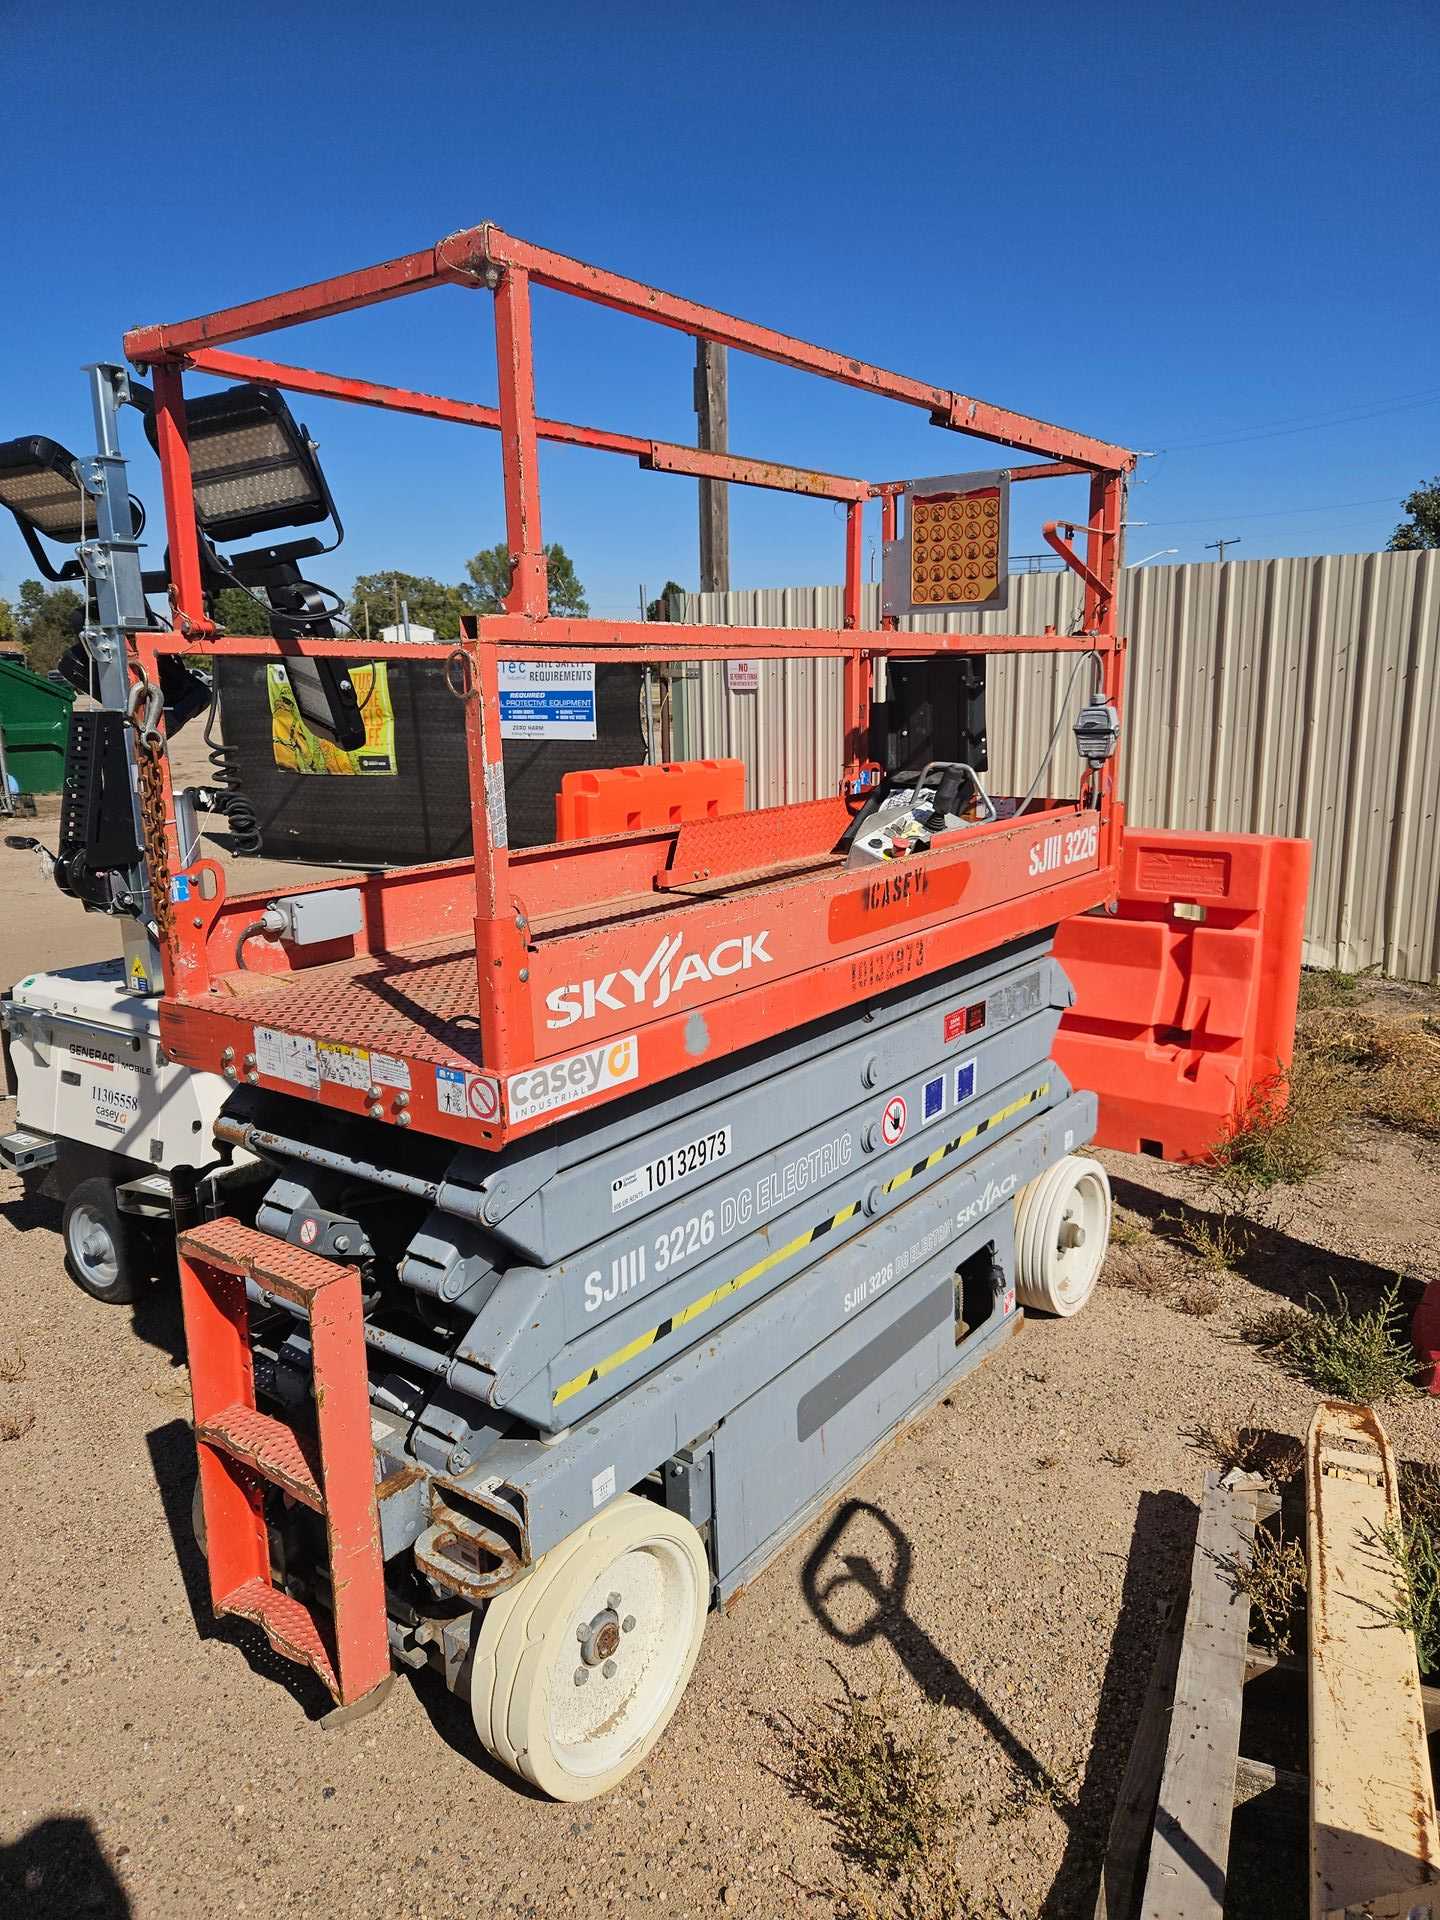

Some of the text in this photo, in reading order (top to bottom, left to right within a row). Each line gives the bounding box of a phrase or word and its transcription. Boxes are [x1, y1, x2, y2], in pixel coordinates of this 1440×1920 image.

[529, 671, 592, 681] REQUIREMENTS
[738, 663, 748, 672] NO
[1029, 826, 1097, 876] SJIII 3226
[871, 868, 922, 910] CASEY
[546, 930, 774, 1029] SKYJACK
[69, 1043, 152, 1075] GENERAC MOBILE
[510, 1050, 606, 1106] casey
[91, 1086, 138, 1111] 11305558
[95, 1105, 120, 1123] casey
[515, 1088, 586, 1119] INDUSTRIAL
[646, 1130, 726, 1191] 10132973
[584, 1133, 852, 1312] SJIII 3226 DC ELECTRIC
[869, 1263, 893, 1294] 3226
